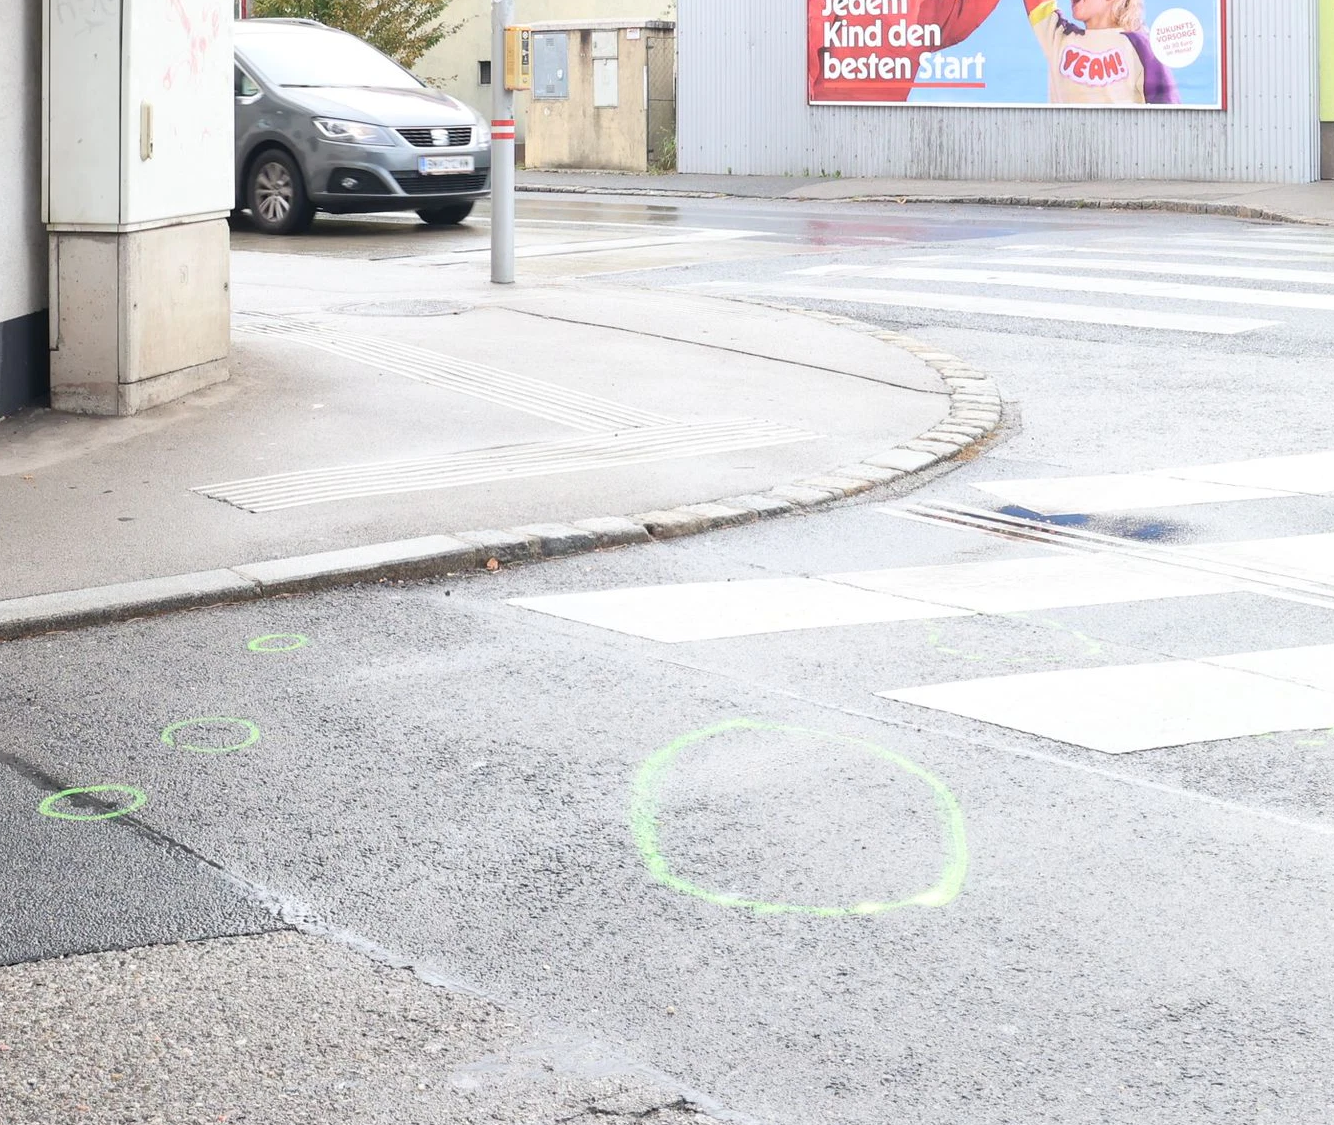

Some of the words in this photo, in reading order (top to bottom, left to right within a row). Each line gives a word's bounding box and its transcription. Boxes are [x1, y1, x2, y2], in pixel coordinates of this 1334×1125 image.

[823, 20, 882, 47] Kind
[888, 20, 942, 47] den
[823, 52, 911, 80] besten
[918, 51, 986, 80] Start
[1063, 49, 1125, 80] YEAH!
